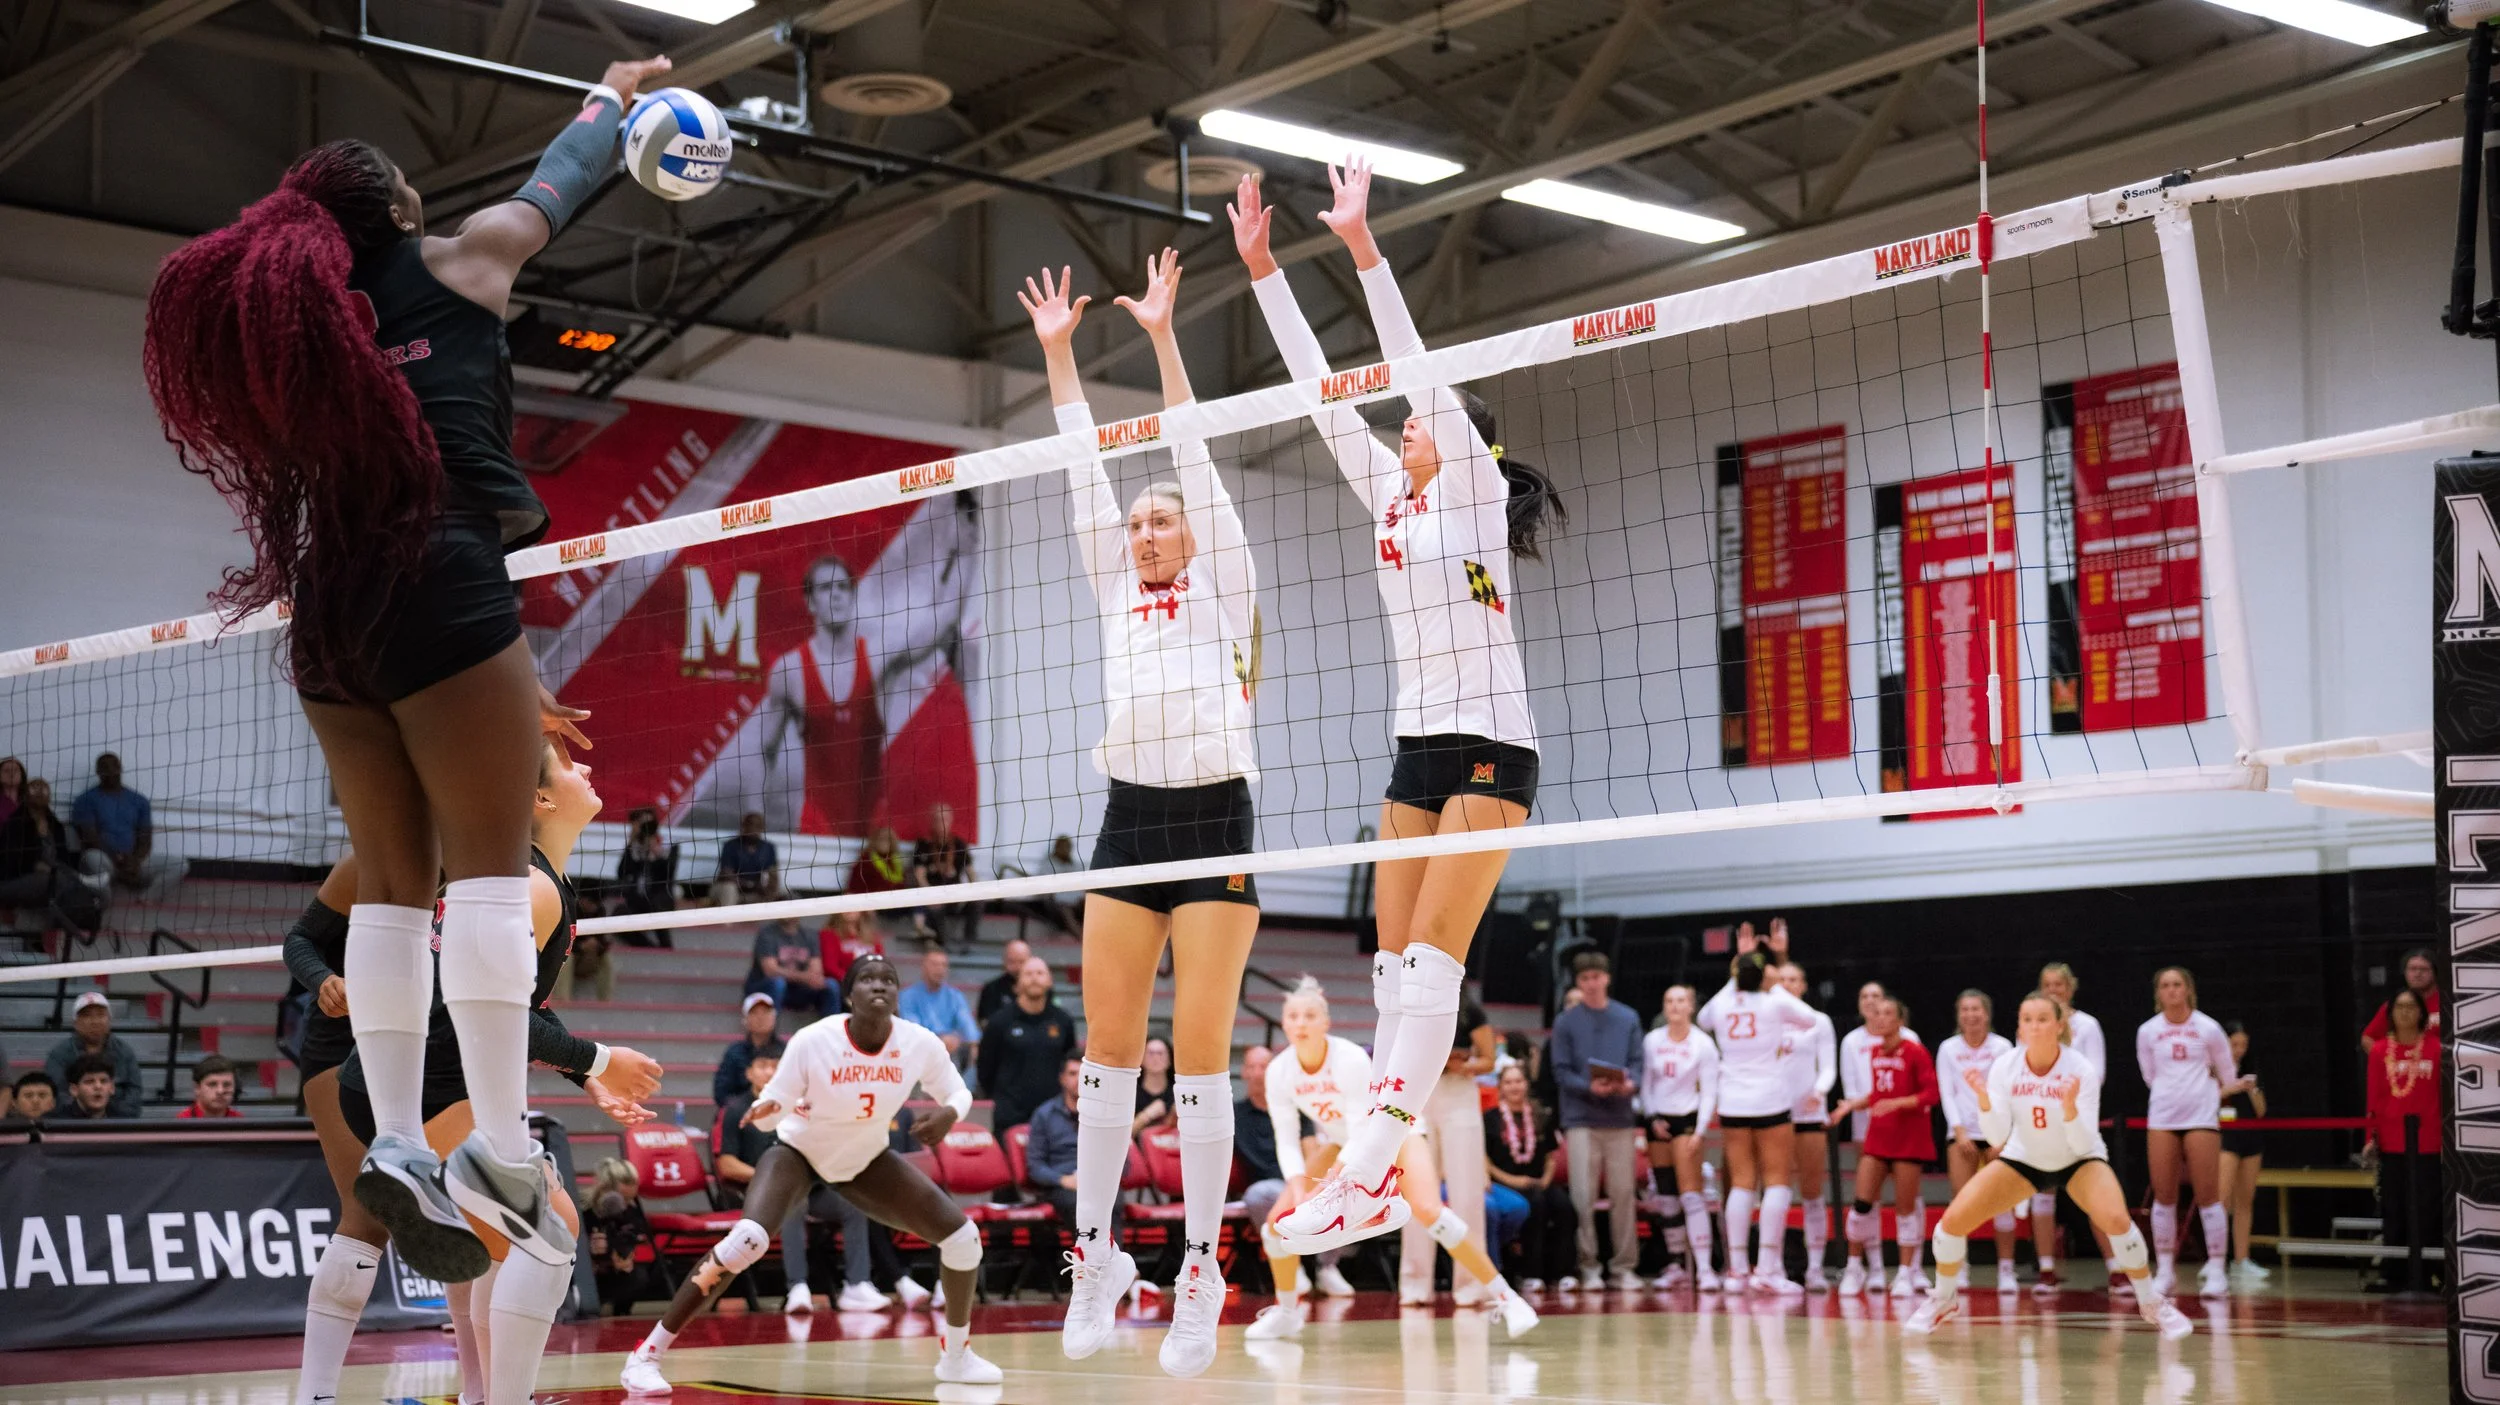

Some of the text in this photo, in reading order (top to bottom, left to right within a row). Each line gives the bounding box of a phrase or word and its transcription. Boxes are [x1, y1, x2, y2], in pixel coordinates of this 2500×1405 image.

[1874, 228, 1971, 275] MARYLAND
[1573, 302, 1657, 341] MARYLAND
[1321, 363, 1391, 399] MARYLAND
[1098, 416, 1160, 446] MARYLAND
[899, 460, 955, 488] MARYLAND
[721, 501, 772, 527] MARYLAND
[560, 535, 606, 560] MARYLAND
[1379, 535, 1403, 571] 4
[682, 565, 761, 667] M
[152, 620, 188, 642] MARYLAND
[1473, 762, 1496, 780] M
[1726, 1011, 1757, 1040] 23
[831, 1065, 903, 1085] MARYLAND
[856, 1093, 876, 1119] 3
[2032, 1106, 2047, 1129] 8
[0, 1208, 332, 1289] ALLENGE
